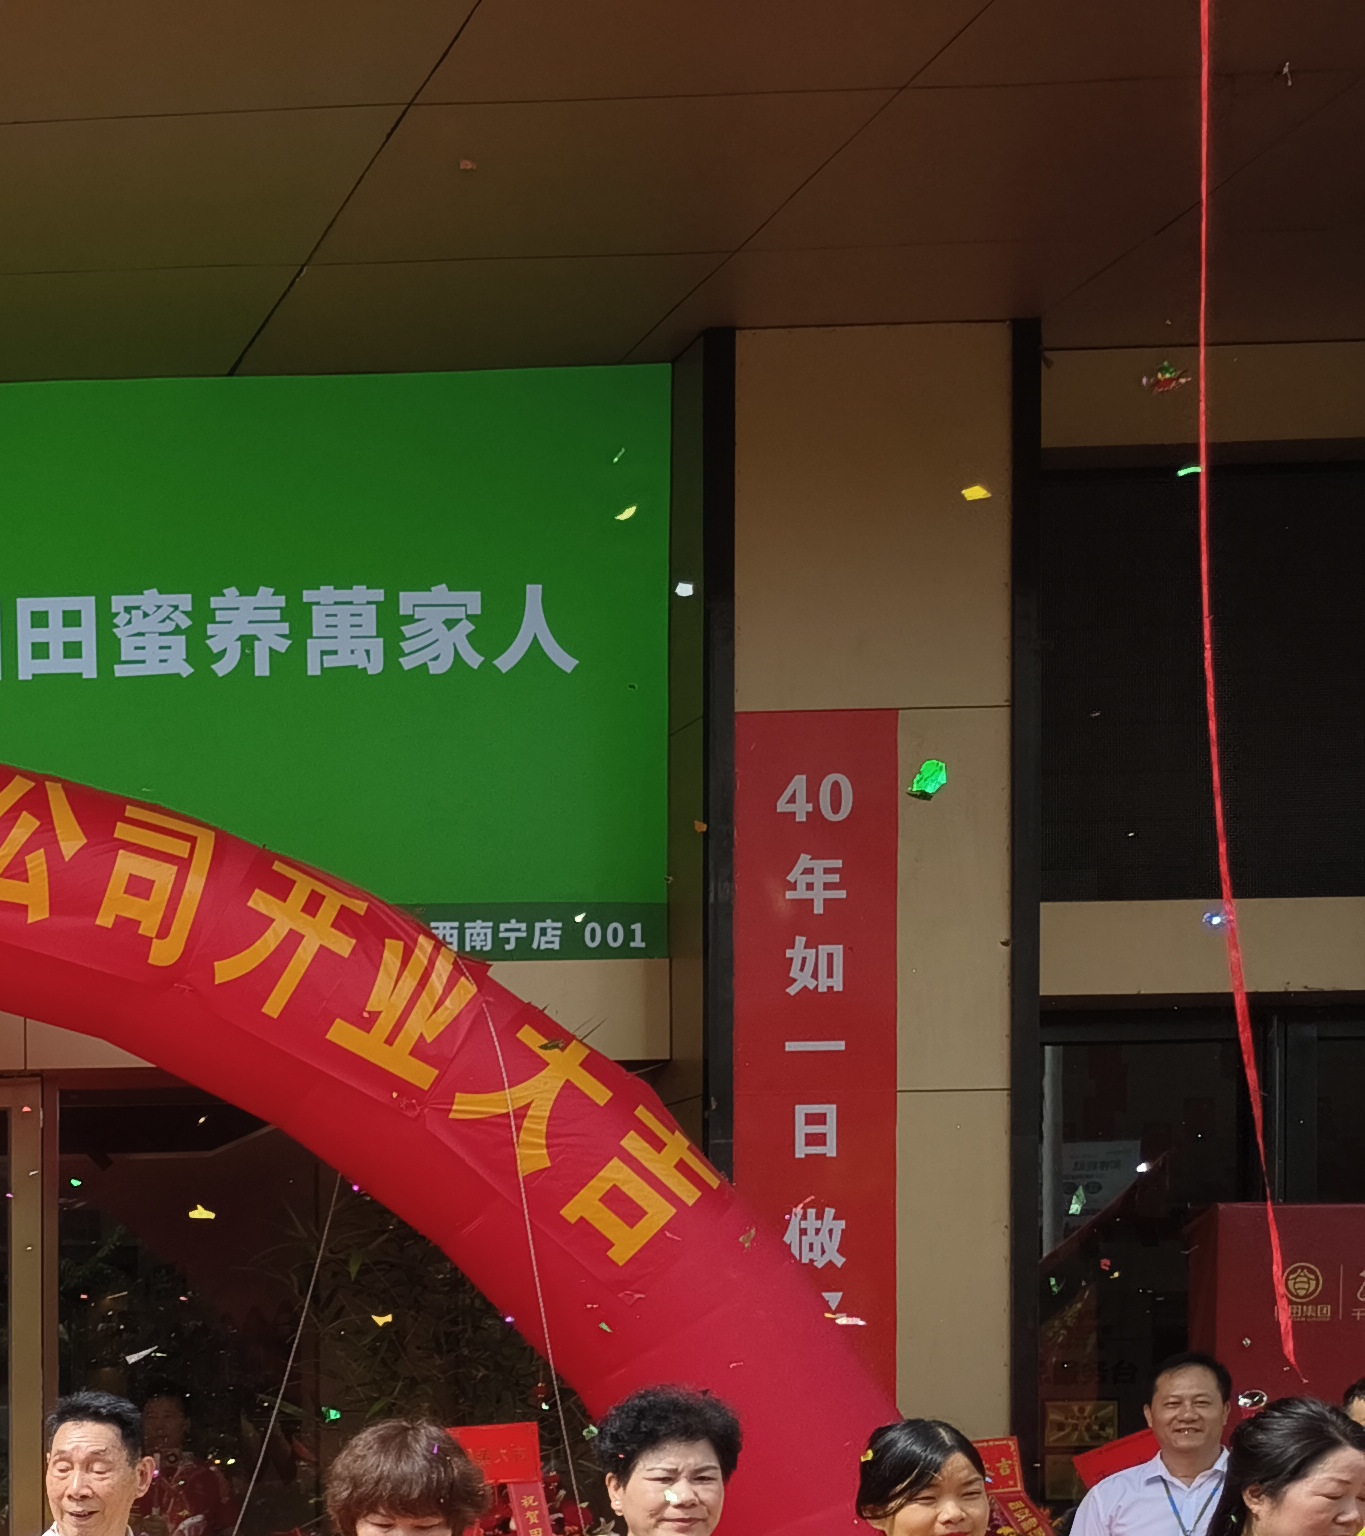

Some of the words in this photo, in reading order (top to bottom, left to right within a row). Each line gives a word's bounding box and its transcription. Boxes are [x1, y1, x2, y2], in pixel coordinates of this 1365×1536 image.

[429, 918, 563, 952] 西南宁店
[583, 921, 647, 949] 001
[782, 1205, 848, 1310] 做
[1274, 1304, 1331, 1318] 田集团
